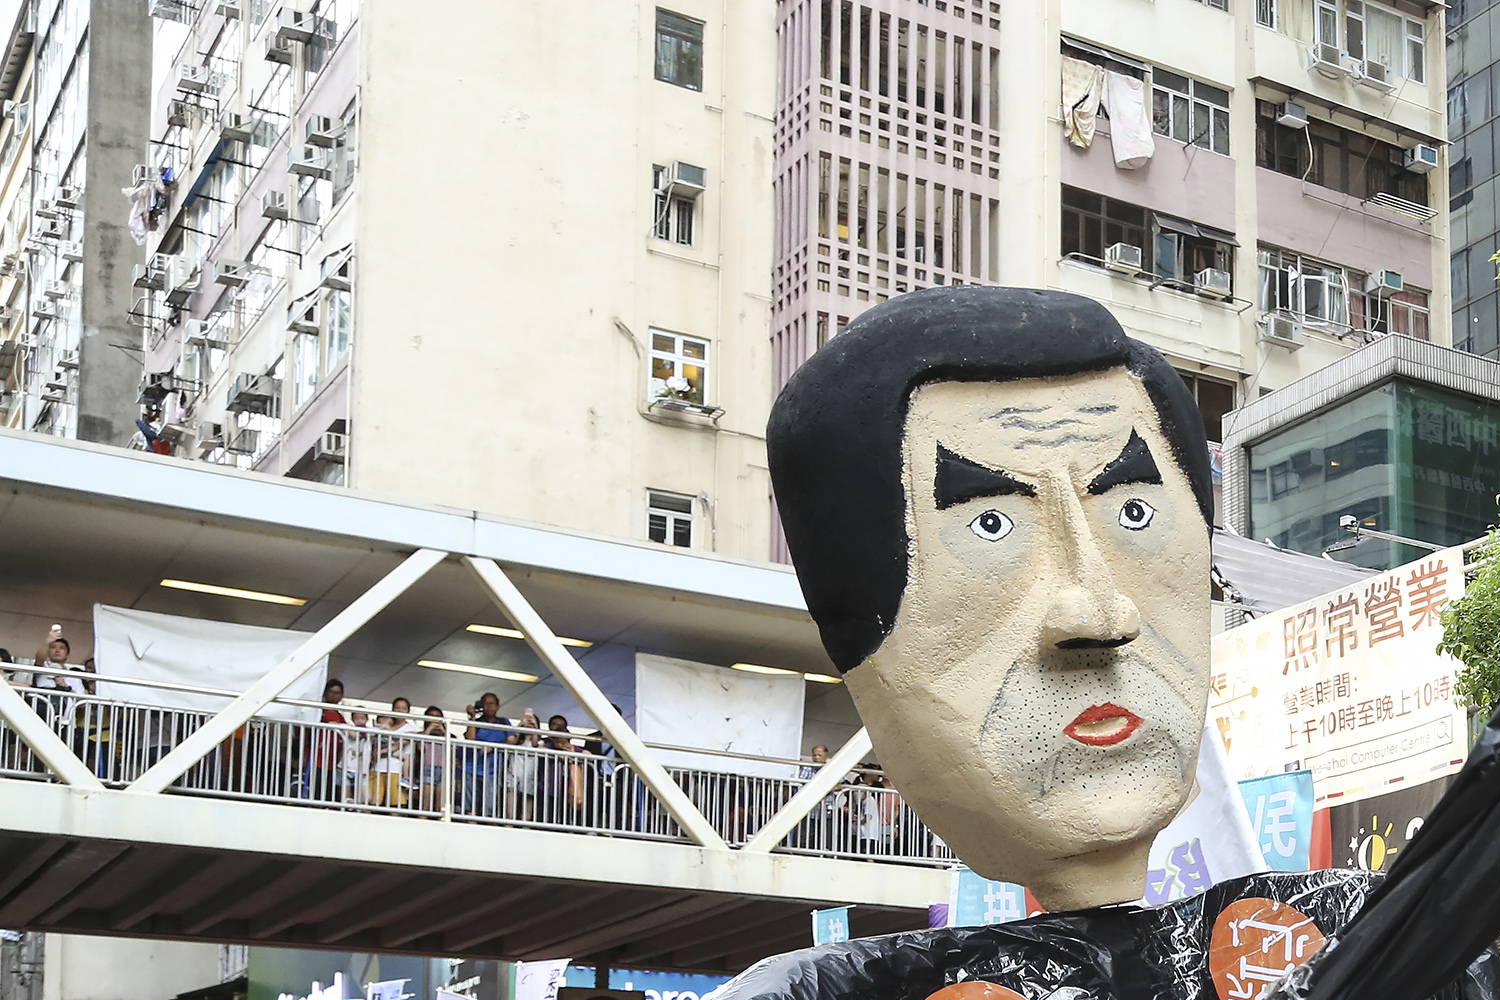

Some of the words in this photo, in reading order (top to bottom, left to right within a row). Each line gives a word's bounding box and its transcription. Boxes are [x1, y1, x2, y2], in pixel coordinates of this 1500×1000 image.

[1282, 559, 1449, 676] 照常營業
[1350, 742, 1399, 766] Computer
[1401, 732, 1431, 752] Centre
